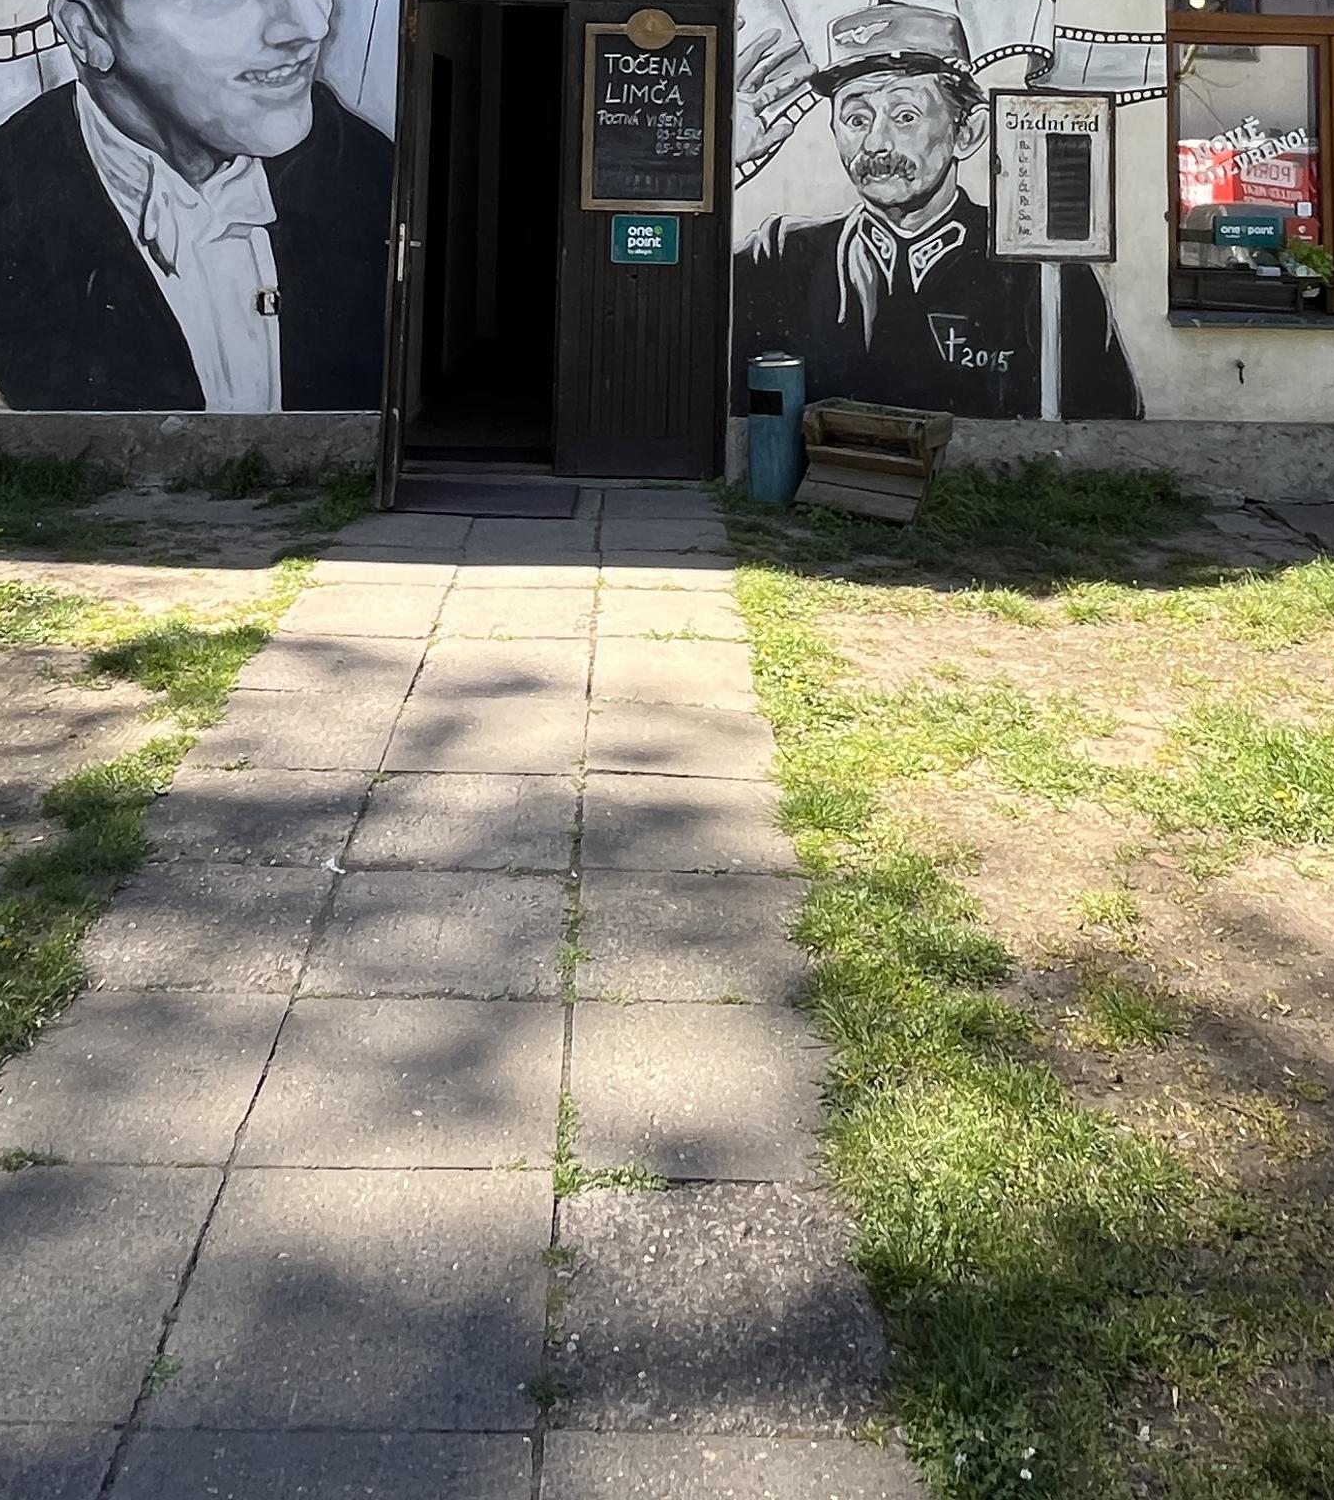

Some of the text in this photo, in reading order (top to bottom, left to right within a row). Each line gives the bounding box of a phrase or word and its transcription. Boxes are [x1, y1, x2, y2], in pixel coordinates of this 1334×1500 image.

[603, 45, 693, 77] TOČENÁ
[605, 79, 685, 106] LIMČA
[1005, 112, 1100, 132] Jízdní řád
[627, 225, 653, 236] one
[1220, 225, 1275, 236] one point
[627, 237, 662, 248] point
